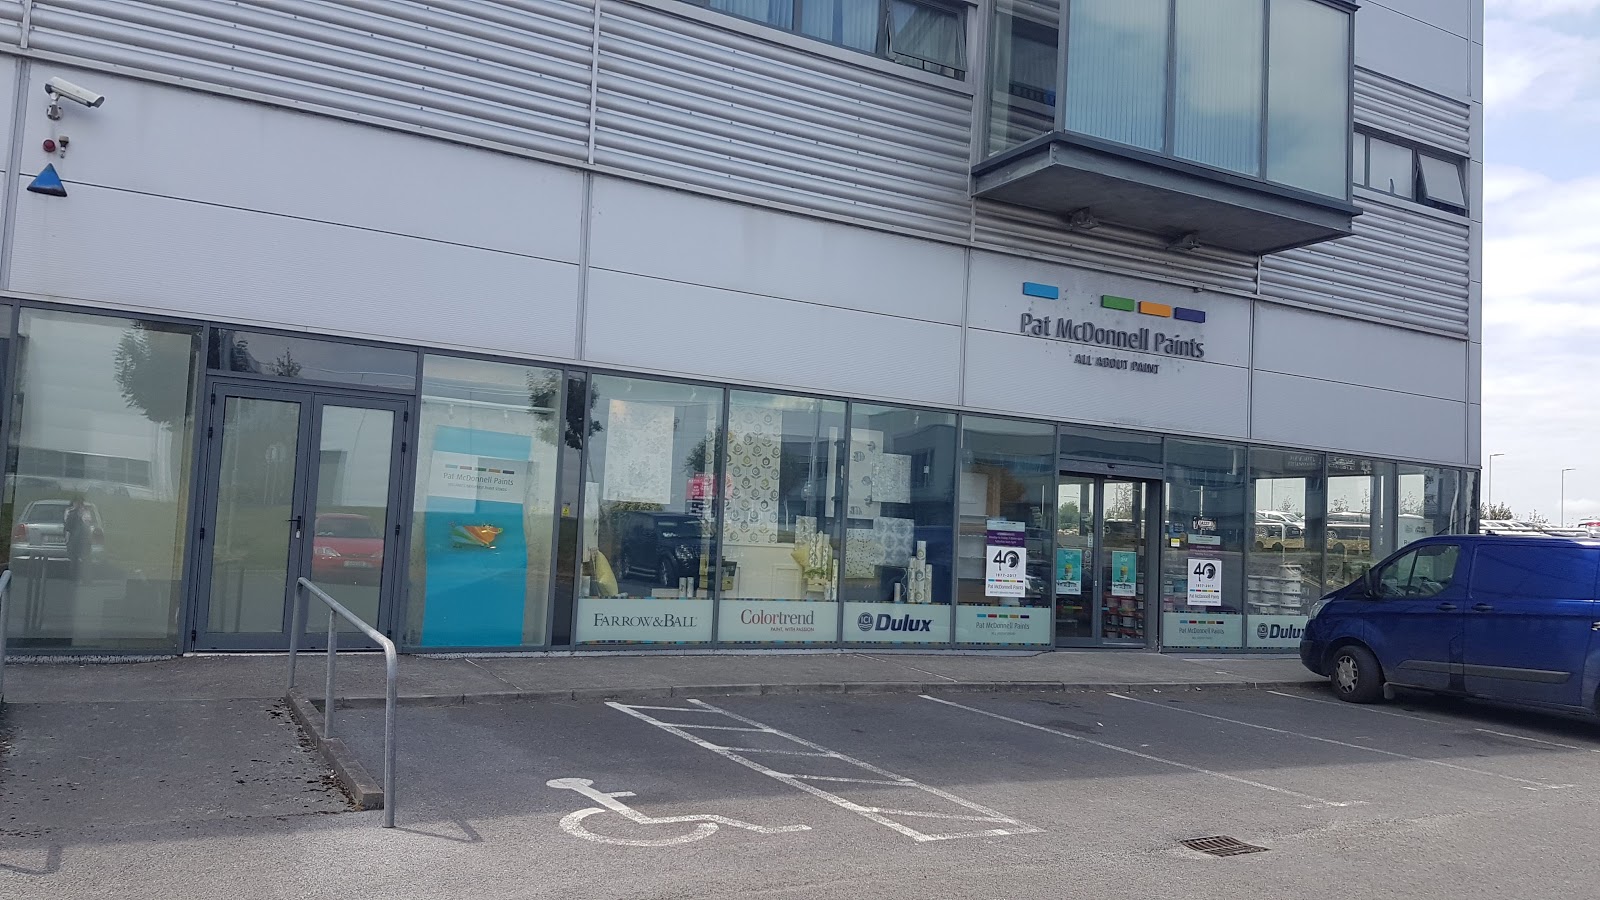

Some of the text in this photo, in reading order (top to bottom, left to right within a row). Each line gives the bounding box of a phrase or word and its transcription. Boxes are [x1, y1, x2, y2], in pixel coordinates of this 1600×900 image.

[1020, 312, 1205, 359] Pat McDonnell Paints
[1074, 354, 1159, 374] ALL ABOUT PAINT
[456, 473, 492, 484] McDonnell
[493, 477, 514, 486] Paints
[993, 549, 1020, 571] 40
[1193, 562, 1216, 582] 40
[741, 608, 814, 625] Colortrend
[875, 613, 932, 632] Dulux
[975, 621, 1030, 630] Pat McDonnell Paints
